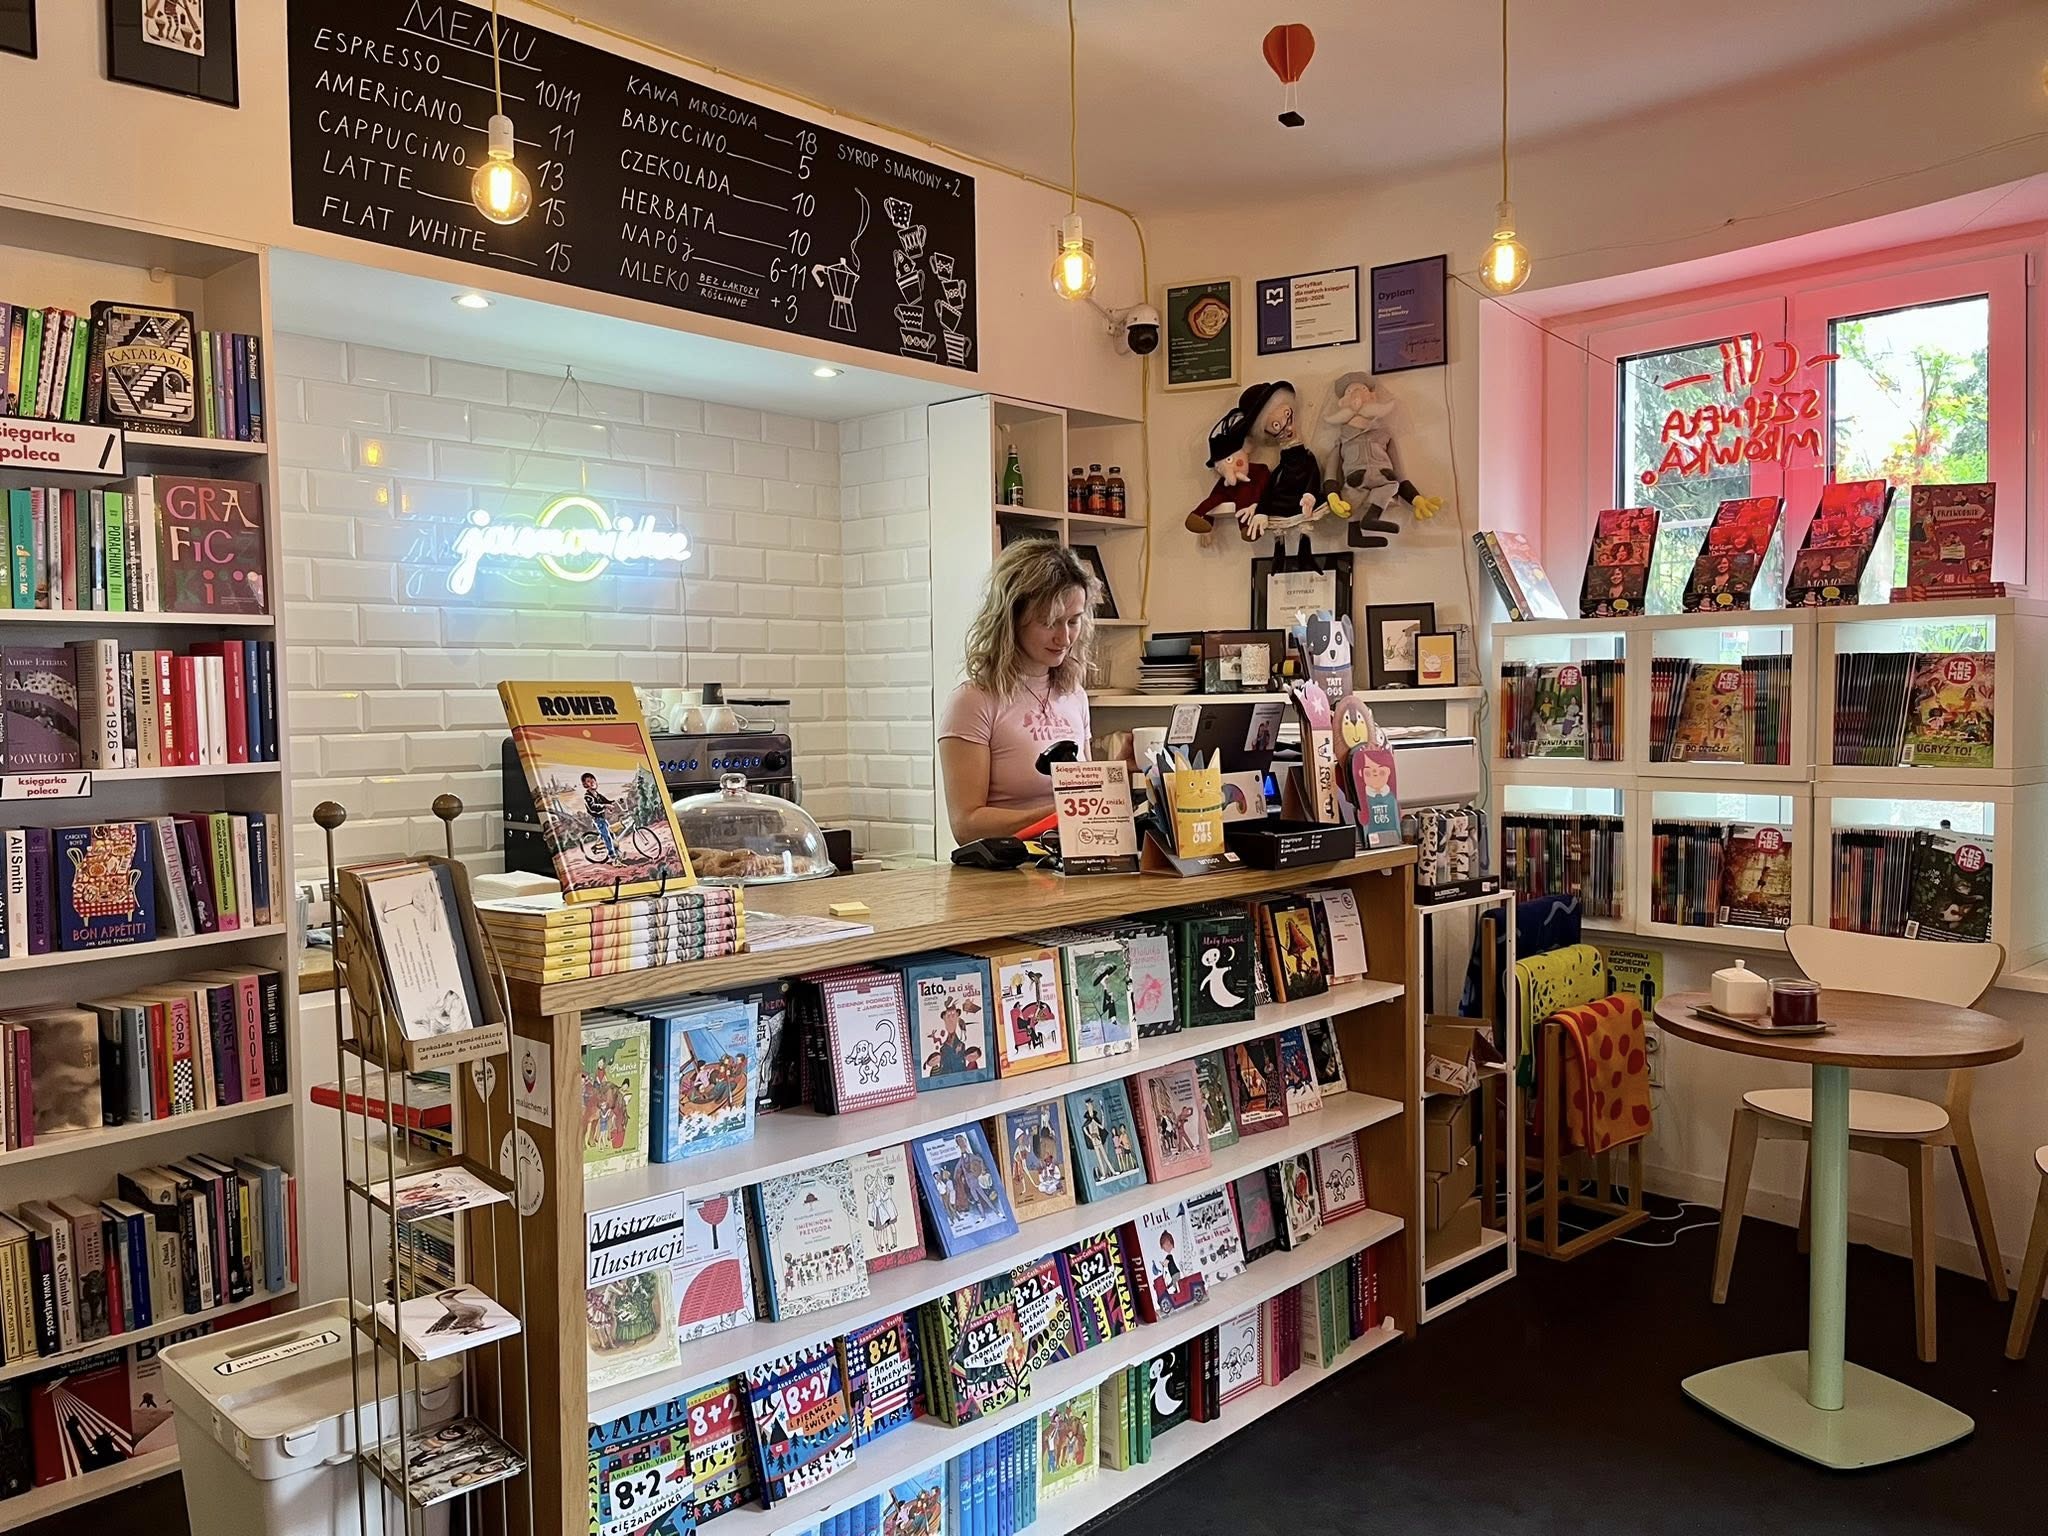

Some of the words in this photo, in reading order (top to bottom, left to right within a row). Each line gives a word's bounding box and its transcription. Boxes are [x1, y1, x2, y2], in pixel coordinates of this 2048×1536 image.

[403, 0, 536, 61] MENU
[313, 28, 441, 74] ESPRESSO
[535, 80, 581, 116] 10/11
[626, 75, 679, 106] KAWA
[688, 97, 757, 130] MROŻONA
[796, 129, 818, 155] 18
[549, 125, 575, 155] 11
[537, 160, 565, 191] 13
[798, 155, 814, 180] 5
[837, 142, 879, 170] SYROP
[884, 158, 941, 190] SMAKOWY
[322, 150, 414, 190] LATTE
[539, 198, 566, 227] 15
[620, 149, 730, 196] CZEKOLADA
[791, 192, 816, 218] 10
[321, 196, 394, 232] FLAT
[545, 241, 572, 273] 15
[621, 186, 716, 234] HERBATA
[788, 228, 811, 257] 10
[620, 257, 690, 293] MLEKO
[699, 273, 719, 286] BEZ
[769, 257, 807, 291] 6-11
[1378, 288, 1415, 301] Dyplom
[107, 348, 190, 370] KATABASIS
[249, 354, 258, 379] Poland
[0, 422, 75, 443] ięgarka
[166, 485, 259, 528] GRA
[108, 525, 122, 579] PORACHUNKI
[6, 658, 33, 666] Annie
[105, 668, 115, 708] MAJ
[537, 696, 618, 716] ROWER
[106, 711, 118, 749] 1926
[18, 776, 67, 787] księgarka
[27, 787, 59, 798] poleca
[1063, 797, 1110, 817] 35%
[1192, 821, 1211, 833] TATT
[1192, 832, 1212, 844] OOS
[11, 836, 23, 854] Ali
[11, 855, 24, 894] Smith
[72, 928, 98, 941] BON
[100, 922, 146, 939] APPÉTIT!
[1608, 957, 1650, 967] BEZPIECZNY
[1609, 949, 1649, 960] ZACHOWAJ
[918, 981, 946, 996] Tato,
[176, 1014, 185, 1052] KORA
[220, 999, 235, 1052] MONET
[246, 990, 258, 1075] GOGOL
[590, 1210, 677, 1245] Mistrzowie
[1142, 1207, 1171, 1228] Pluk
[590, 1233, 684, 1279] Ilustracji
[1080, 1252, 1106, 1282] 8+2
[42, 1273, 52, 1299] NOWA
[1132, 1257, 1149, 1292] Pluk
[1014, 1279, 1041, 1307] 8+2
[43, 1299, 56, 1337] MĘSKOŚĆ
[869, 1330, 898, 1365] 8+2
[967, 1323, 998, 1354] 8+2
[809, 1362, 828, 1375] Vestly
[785, 1375, 825, 1416] 8+2
[690, 1393, 741, 1437] 8+2
[611, 1462, 651, 1481] Anne-Cath.
[655, 1453, 678, 1466] Vestly
[690, 1445, 719, 1463] OMEK
[614, 1469, 662, 1511] 8+2
